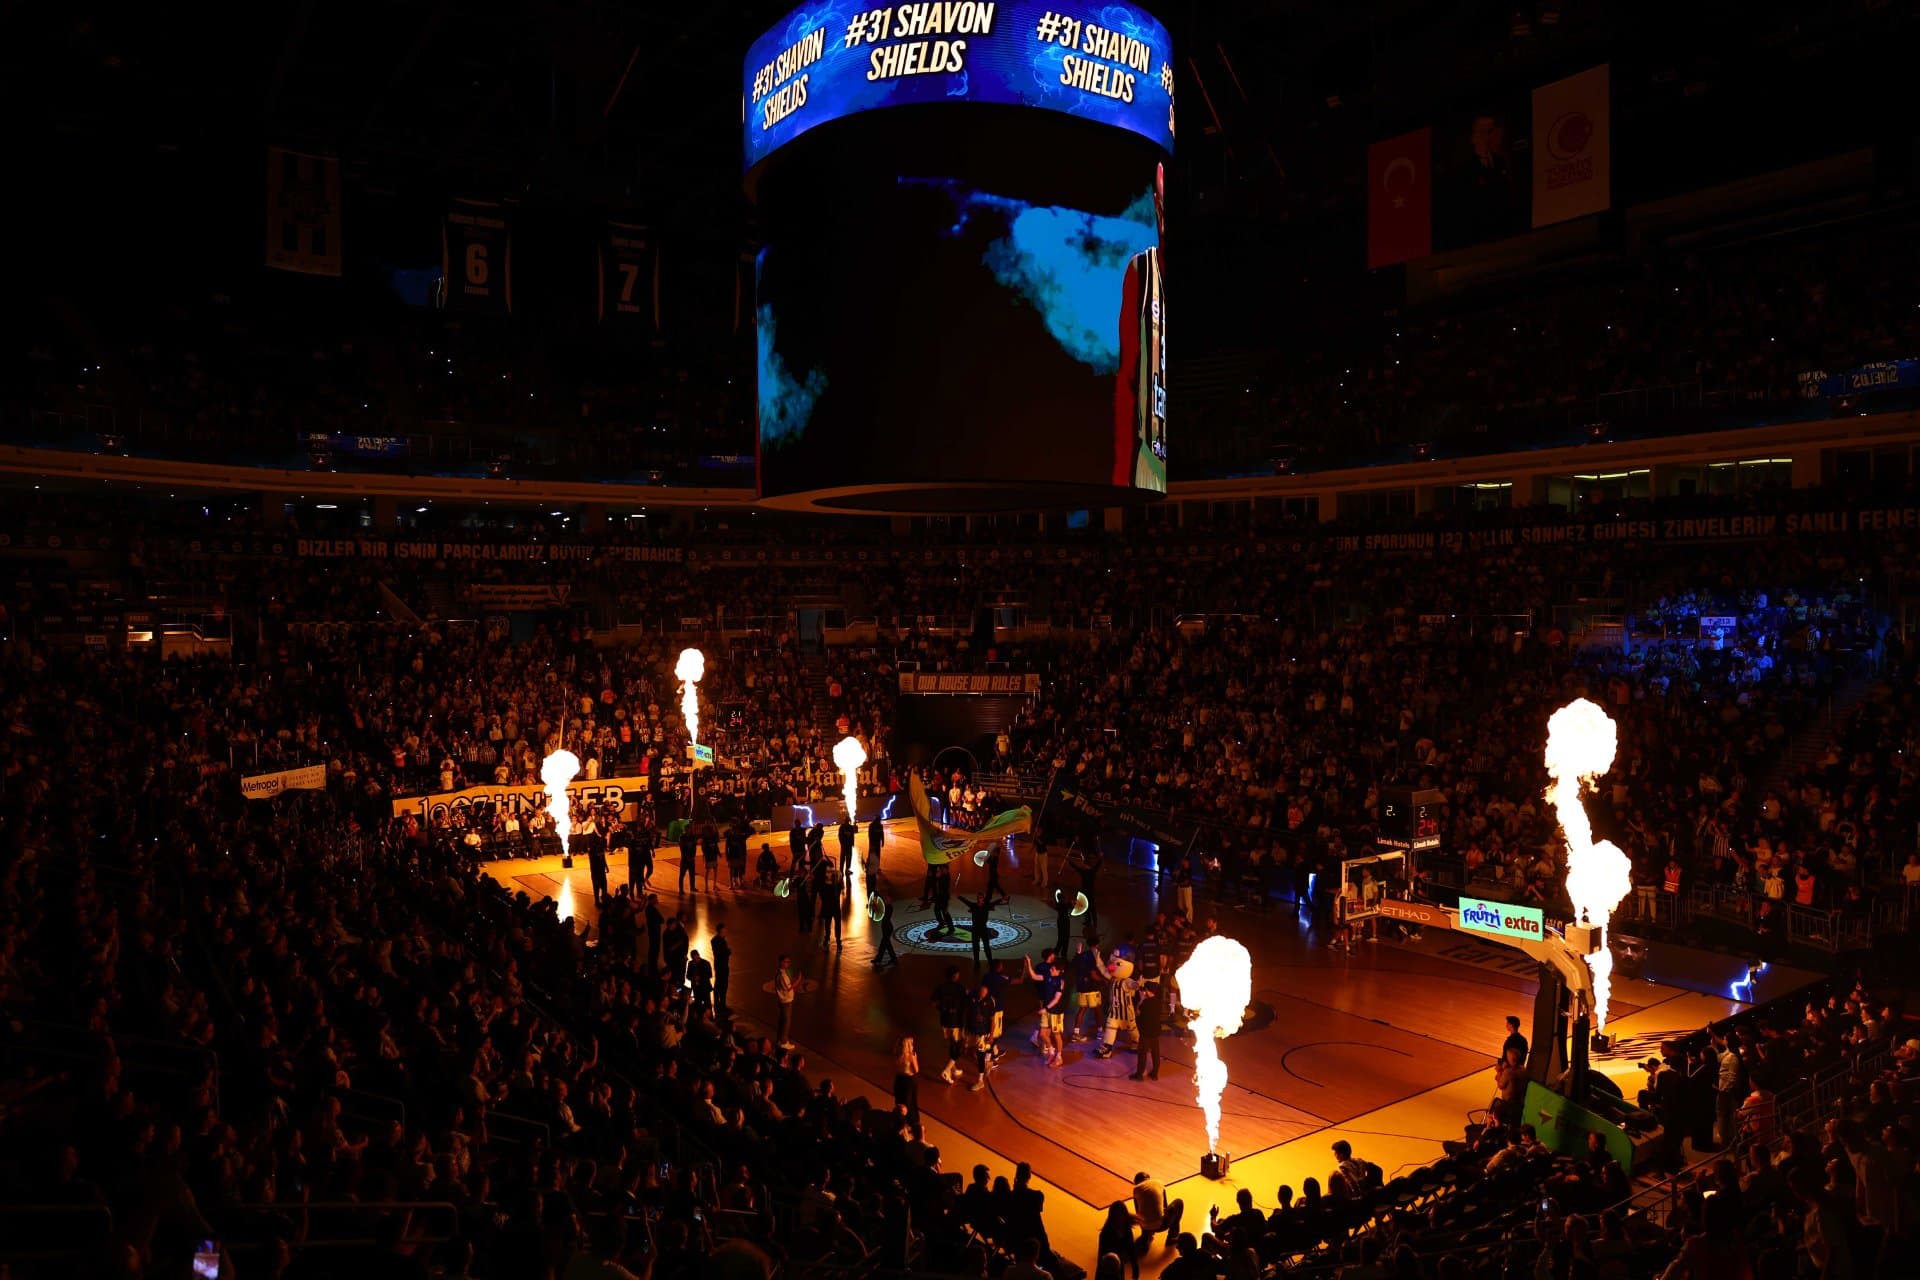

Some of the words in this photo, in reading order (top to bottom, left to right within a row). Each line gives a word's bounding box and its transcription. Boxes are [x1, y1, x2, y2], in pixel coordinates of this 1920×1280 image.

[845, 7, 891, 49] #31
[893, 2, 995, 37] SHAVON
[1036, 11, 1081, 50] #31
[1083, 23, 1150, 74] SHAVON
[752, 60, 777, 103] #31
[774, 27, 825, 91] SHAVON
[867, 40, 967, 82] SHIELDS
[1060, 54, 1135, 103] SHIELDS
[763, 73, 808, 131] SHIELDS
[465, 243, 489, 285] 6
[618, 263, 640, 302] 7
[1857, 506, 1920, 532] FENE
[1381, 906, 1431, 921] ETIHAD
[1505, 916, 1539, 933] extra
